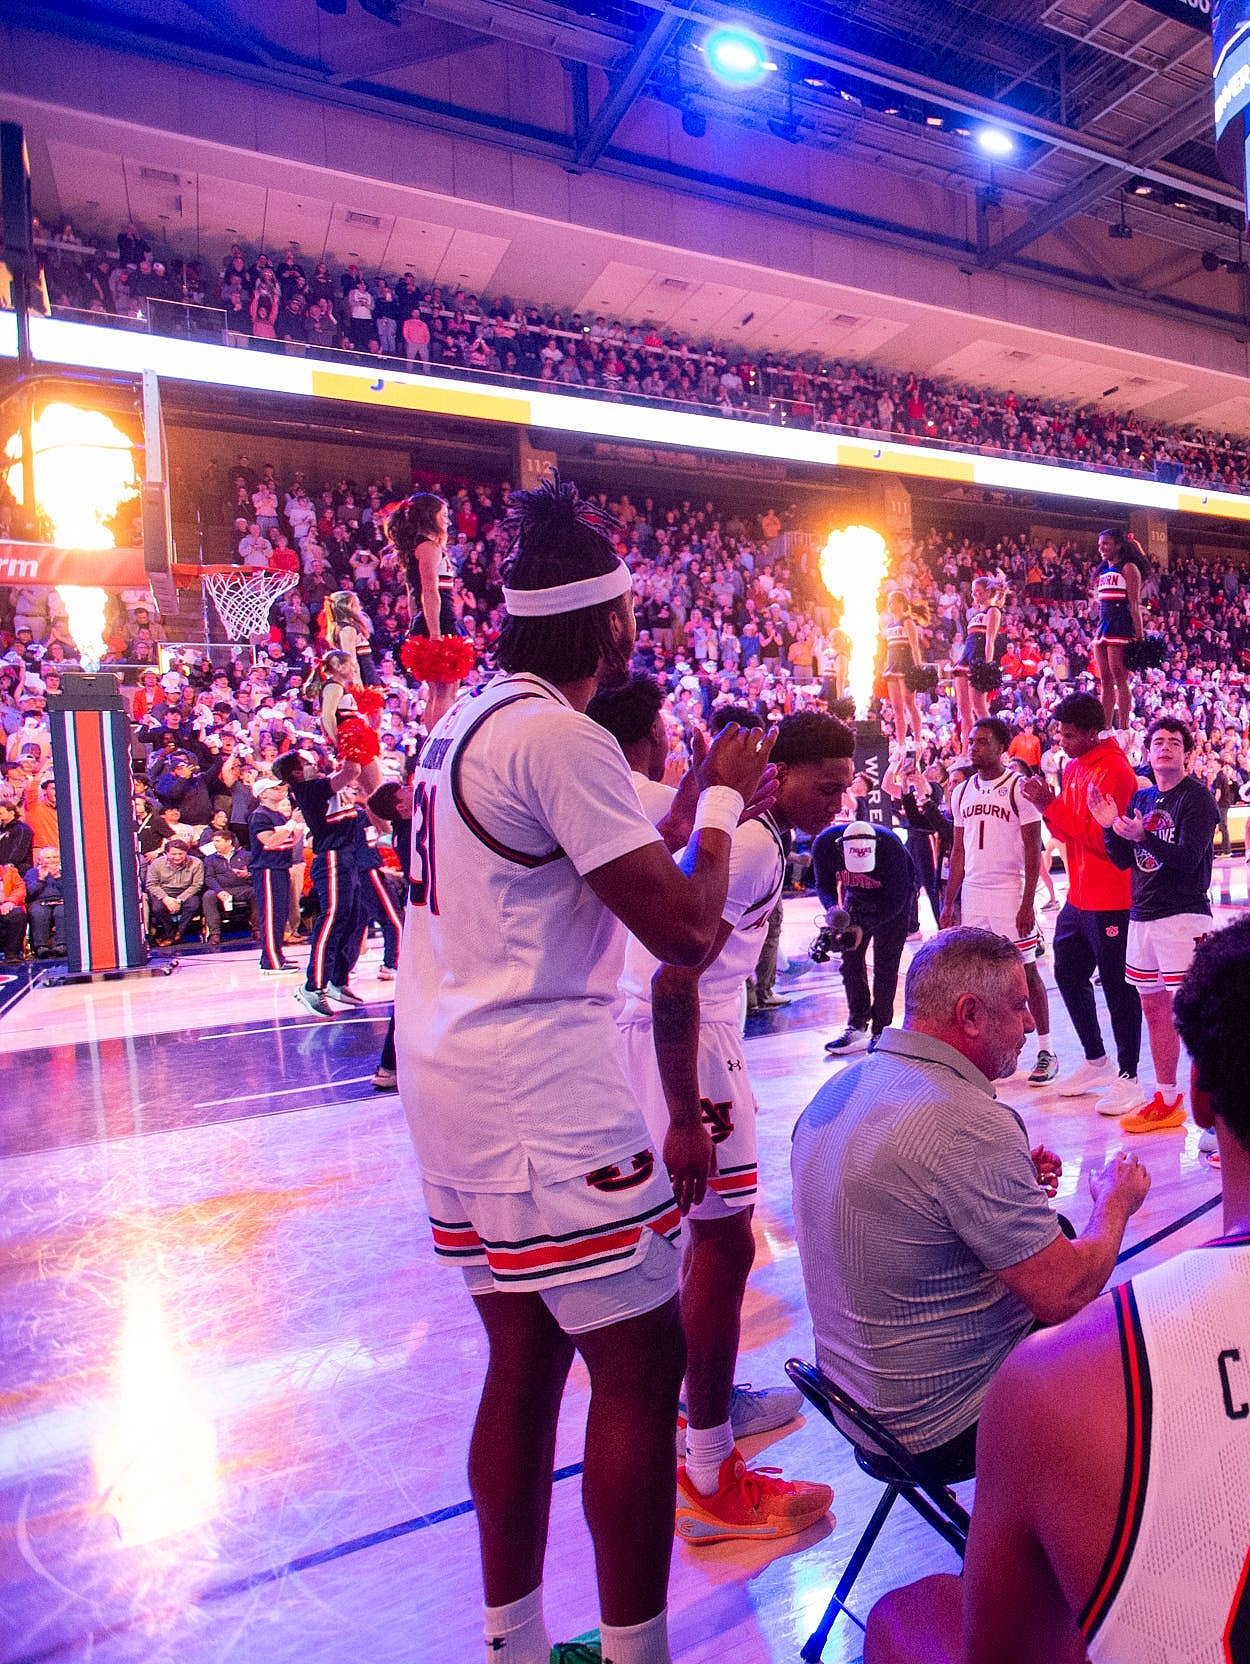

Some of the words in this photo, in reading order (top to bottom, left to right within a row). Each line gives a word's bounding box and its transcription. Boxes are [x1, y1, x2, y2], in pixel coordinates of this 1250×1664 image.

[0, 558, 38, 577] rm
[408, 781, 440, 915] 31
[978, 821, 984, 850] 1
